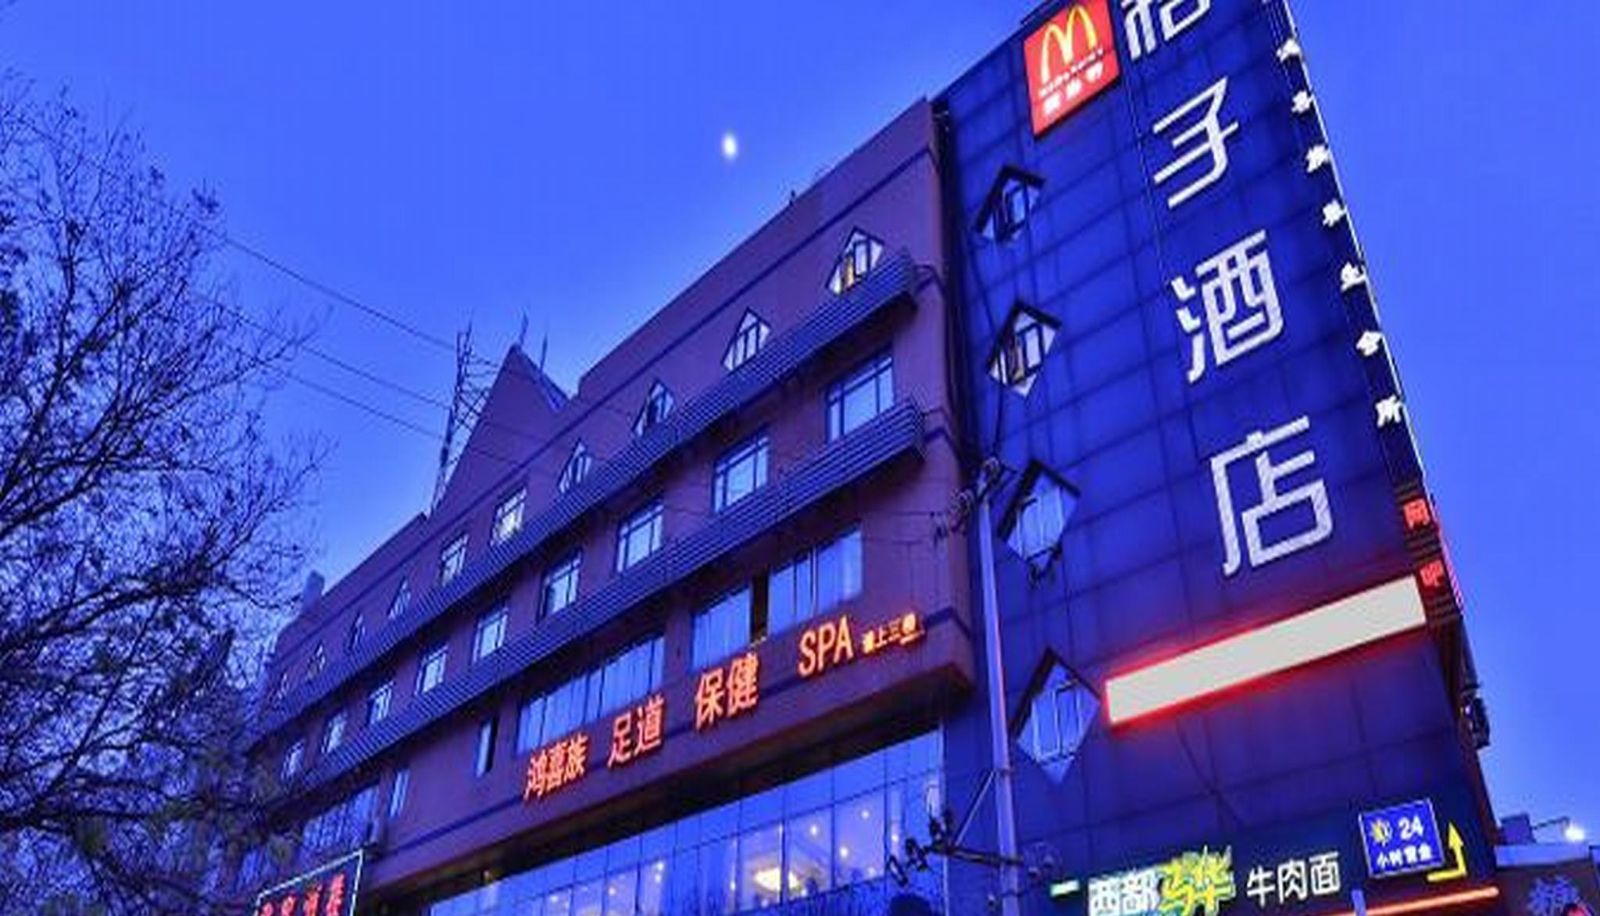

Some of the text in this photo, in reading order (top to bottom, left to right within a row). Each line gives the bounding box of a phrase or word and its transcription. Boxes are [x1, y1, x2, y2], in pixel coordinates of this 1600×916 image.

[523, 733, 589, 800] 鸿喜族
[607, 694, 665, 768] 足道
[694, 651, 760, 731] 保健
[798, 613, 854, 677] SPA
[1398, 814, 1424, 840] 24
[1246, 851, 1341, 908] 牛肉面
